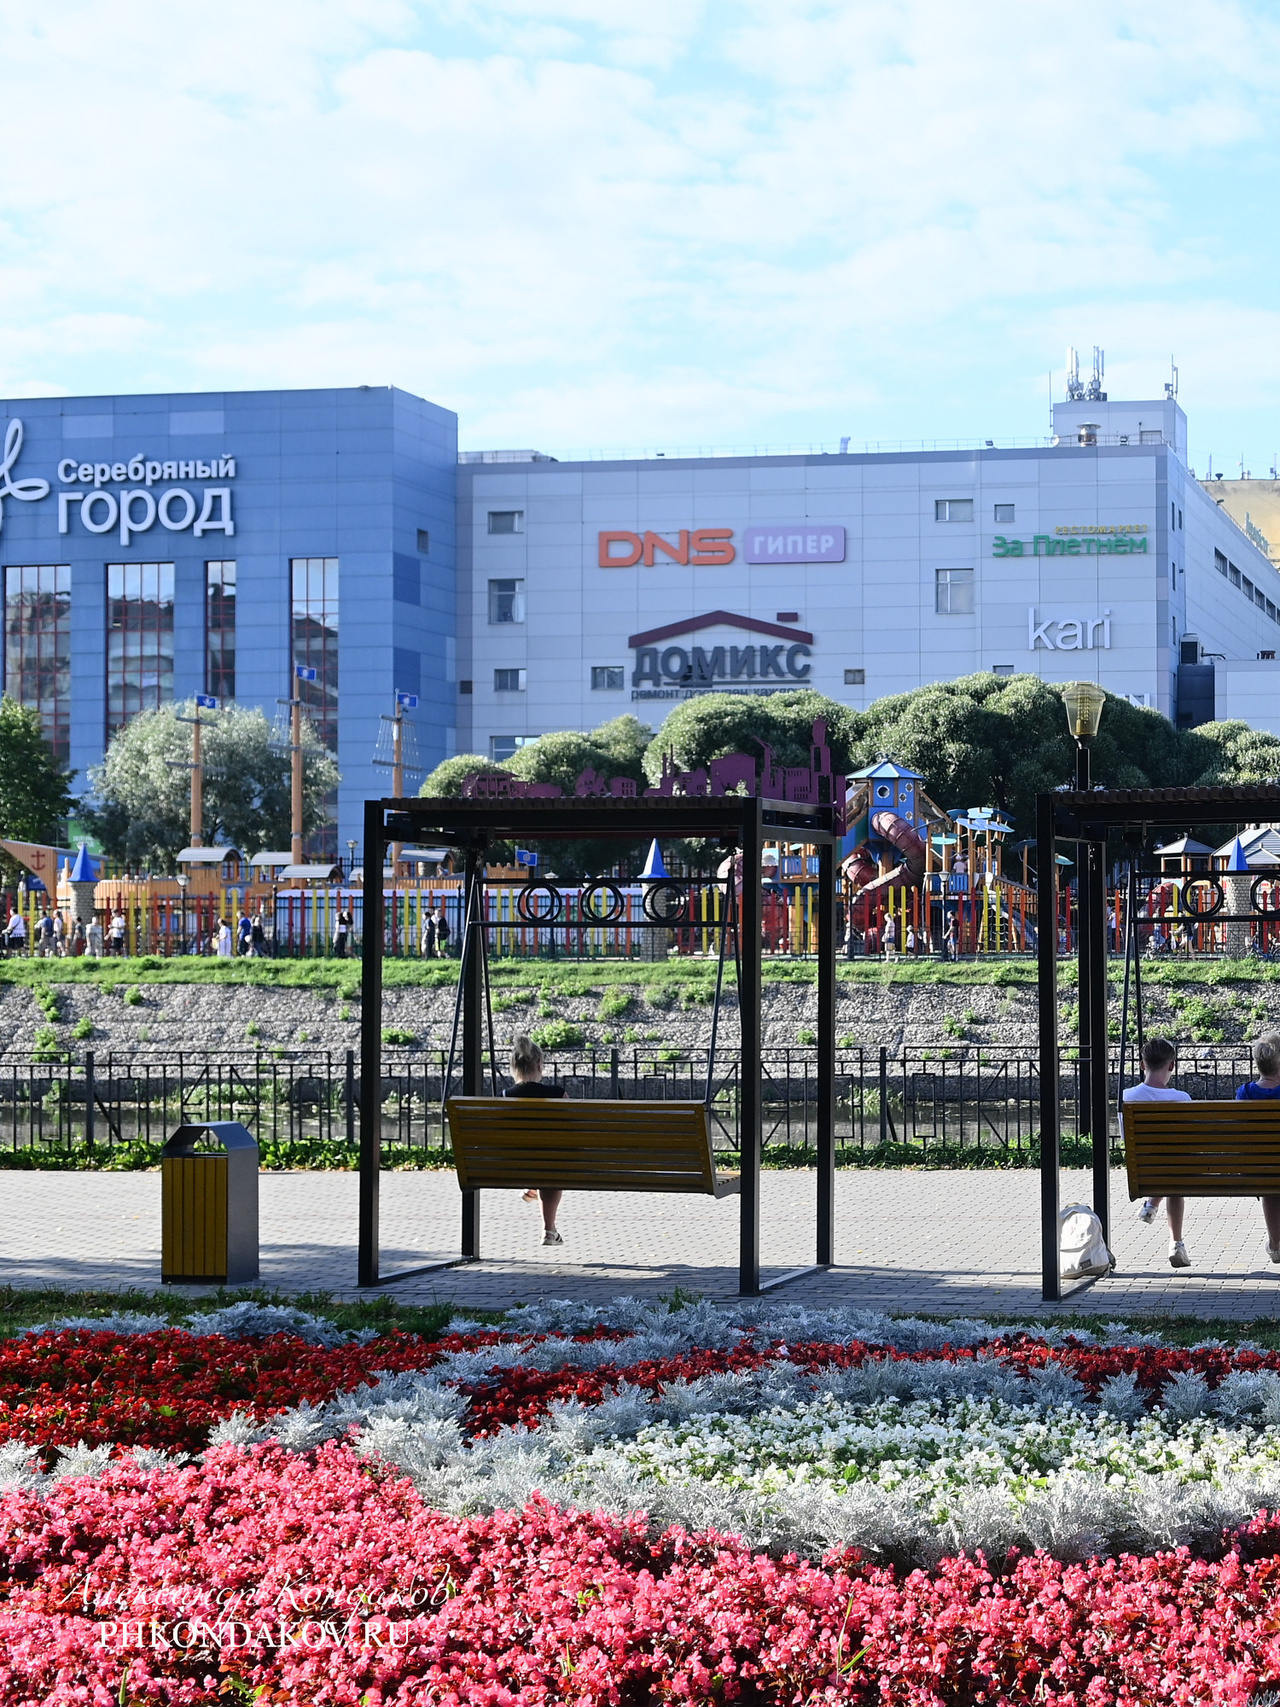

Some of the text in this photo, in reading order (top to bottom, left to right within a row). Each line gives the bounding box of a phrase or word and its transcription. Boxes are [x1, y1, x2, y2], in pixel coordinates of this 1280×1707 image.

[57, 453, 236, 487] Серебряный
[1055, 524, 1148, 534] РЕСТОМАРКЕТ
[598, 528, 736, 567] DNS
[753, 534, 835, 555] ГИПЕР
[992, 532, 1148, 557] За Плетнём
[1027, 607, 1112, 651] kari
[631, 643, 812, 687] ДОМИКС
[631, 688, 680, 702] ремонт
